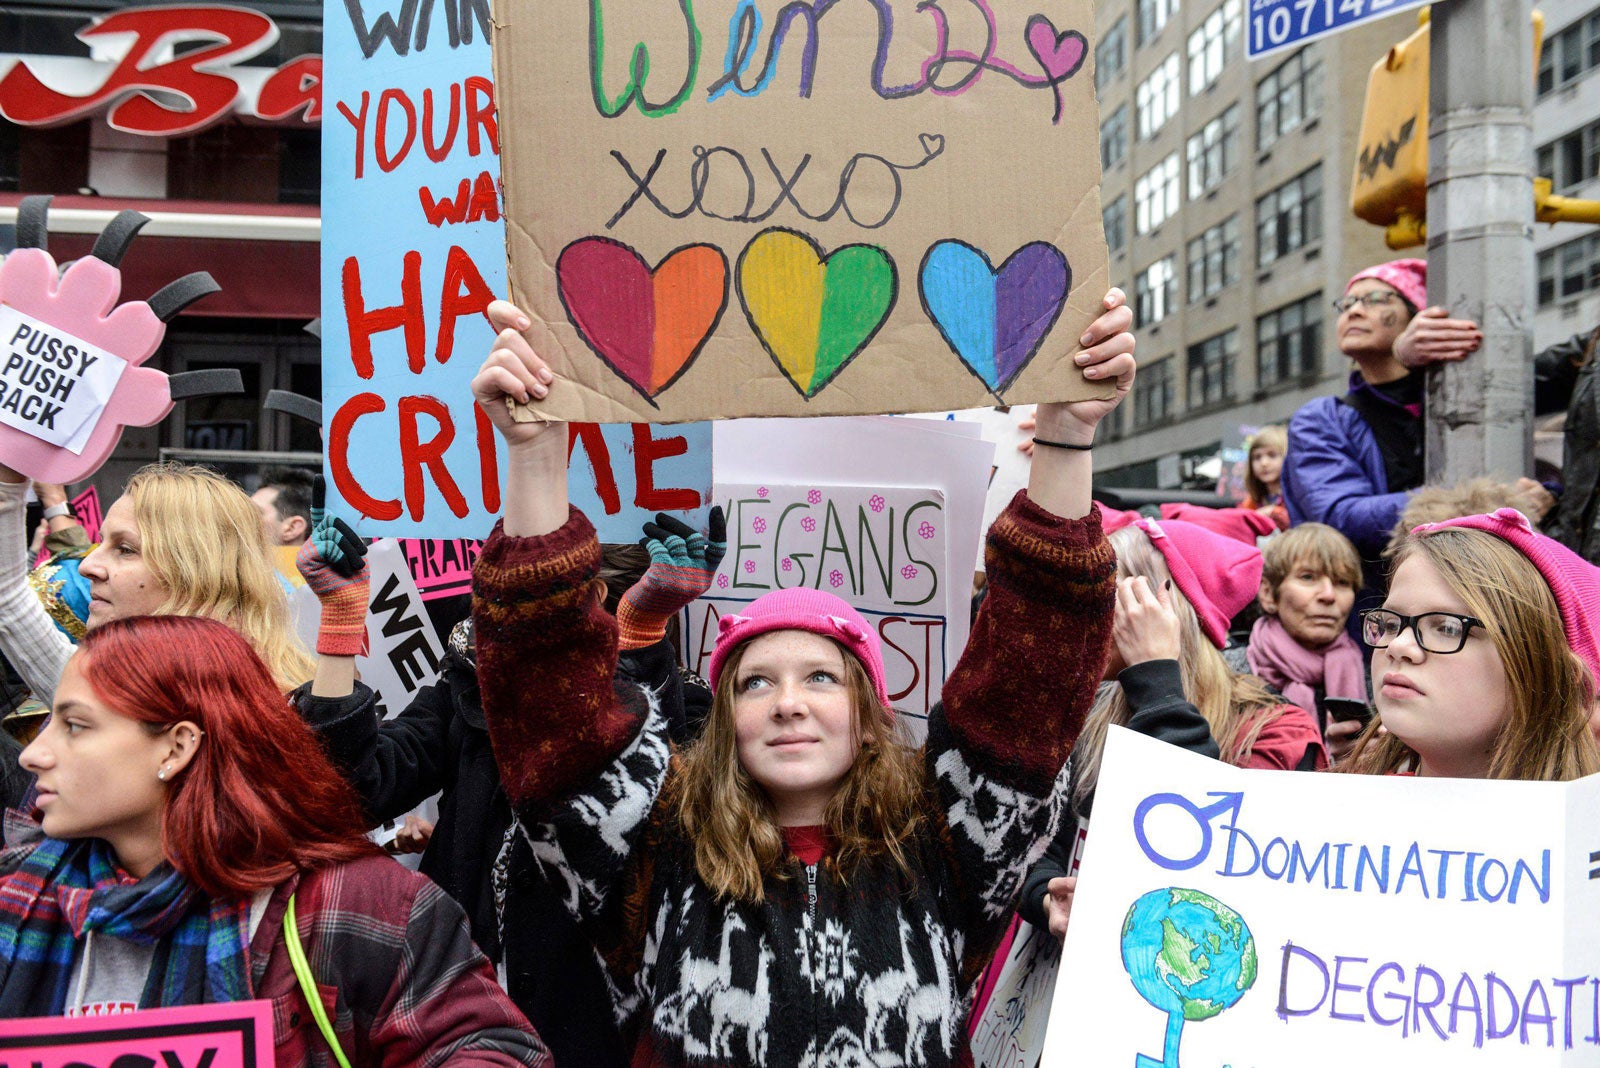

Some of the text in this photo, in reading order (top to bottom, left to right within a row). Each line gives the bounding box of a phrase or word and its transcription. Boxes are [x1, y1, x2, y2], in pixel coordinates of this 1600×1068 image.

[336, 76, 500, 180] YOUR
[418, 171, 502, 228] WA
[1, 352, 76, 403] PUSH
[9, 323, 99, 378] PUSSY
[724, 497, 943, 606] EGANS
[369, 571, 439, 694] WE
[1216, 824, 1551, 904] DOMINATION
